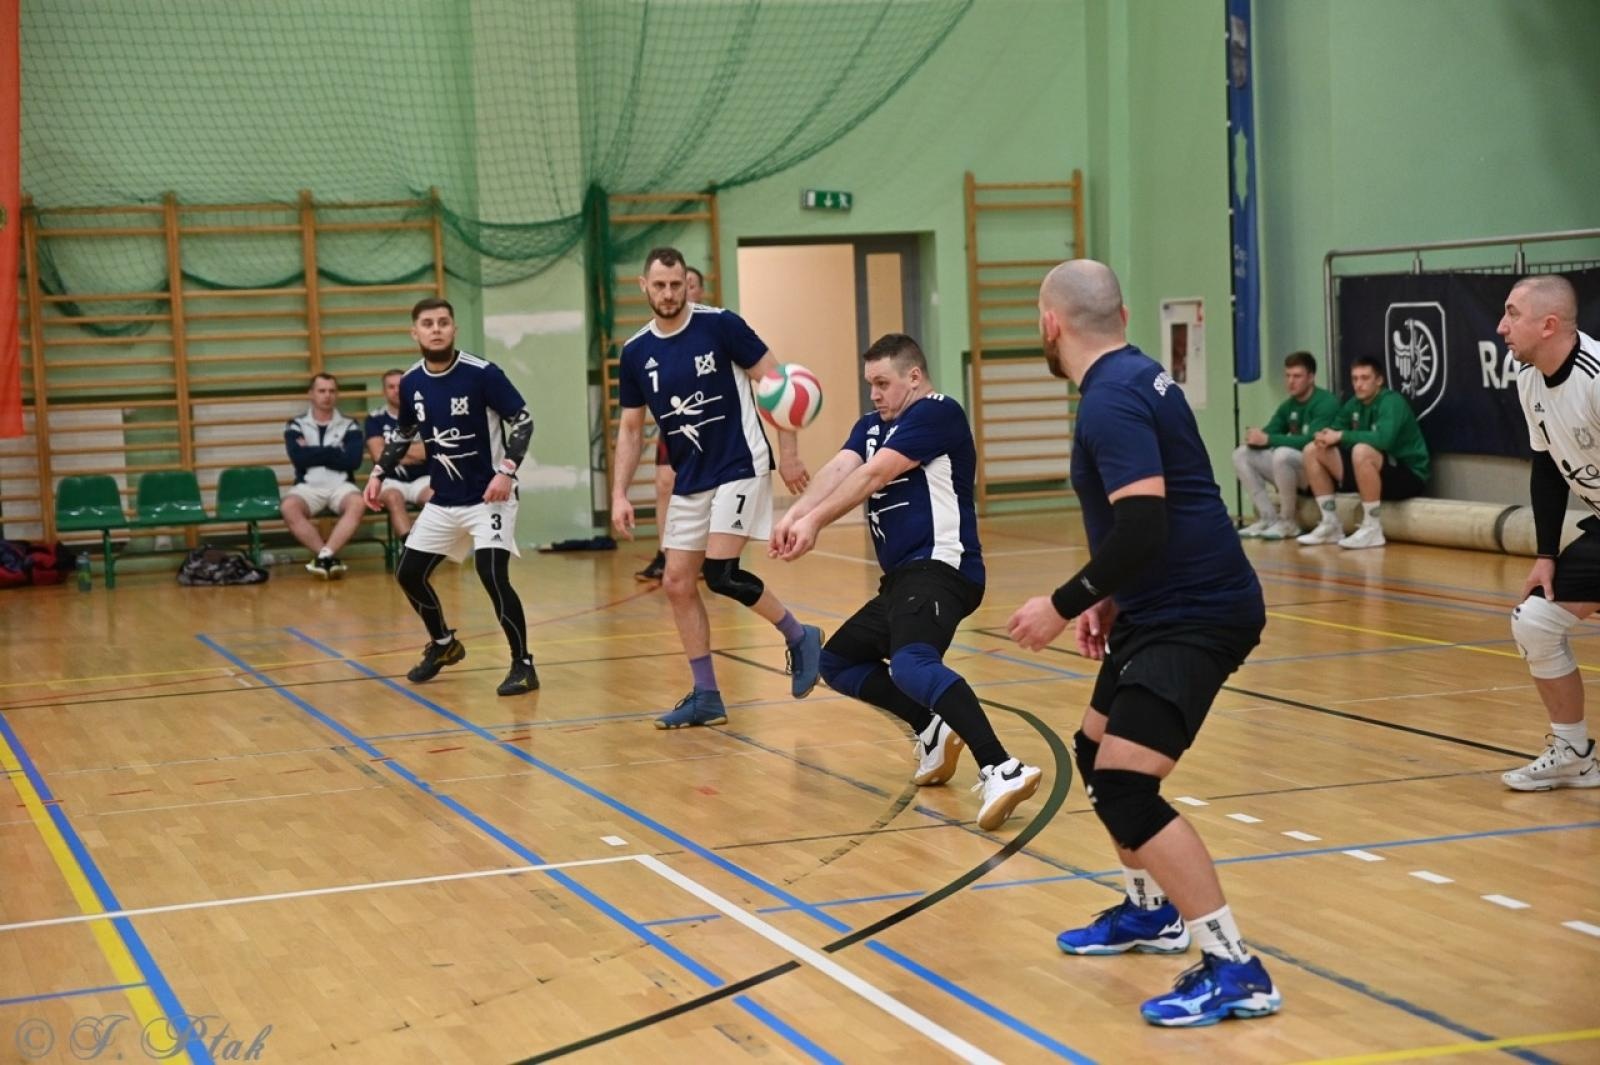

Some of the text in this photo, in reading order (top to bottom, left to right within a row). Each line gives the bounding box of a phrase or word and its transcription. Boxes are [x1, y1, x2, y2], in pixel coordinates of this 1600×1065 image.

[414, 402, 426, 422] 3
[736, 494, 746, 515] 7
[490, 513, 502, 531] 3
